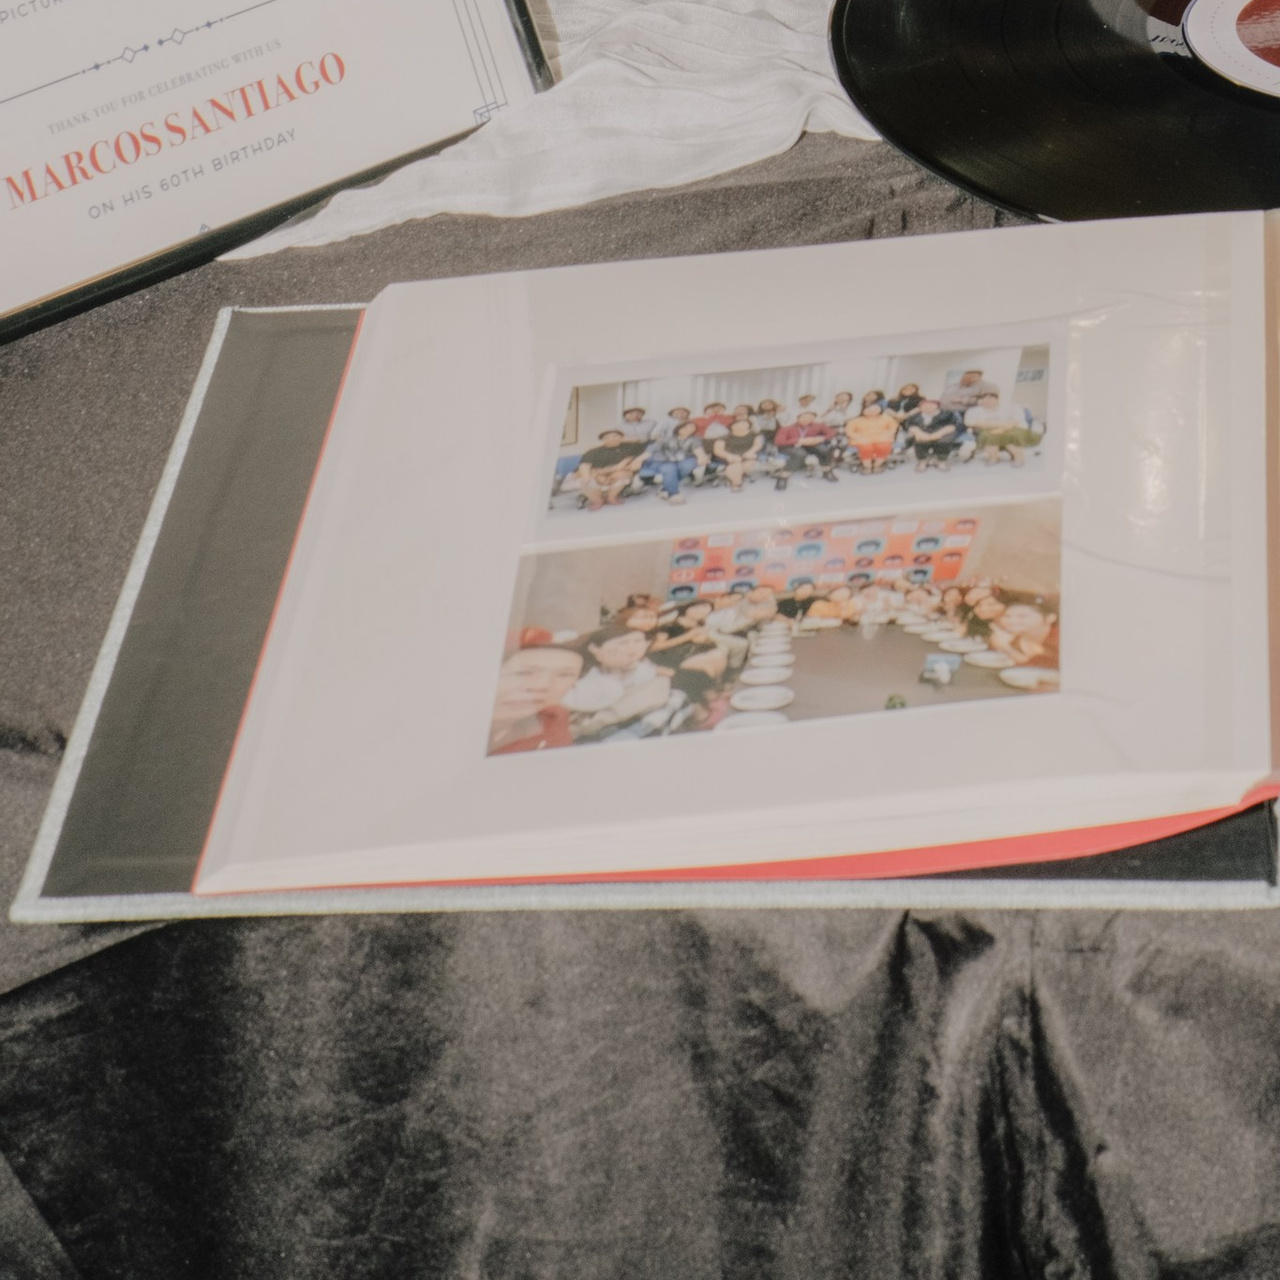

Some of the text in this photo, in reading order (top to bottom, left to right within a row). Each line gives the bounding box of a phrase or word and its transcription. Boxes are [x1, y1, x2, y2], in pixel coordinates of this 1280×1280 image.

[3, 51, 346, 211] MARCOS SANTIAGO
[47, 38, 283, 136] THANK YOU FOR CELEBRATING WITH US
[88, 127, 297, 221] ON HIS 60TH BIRTHDAY
